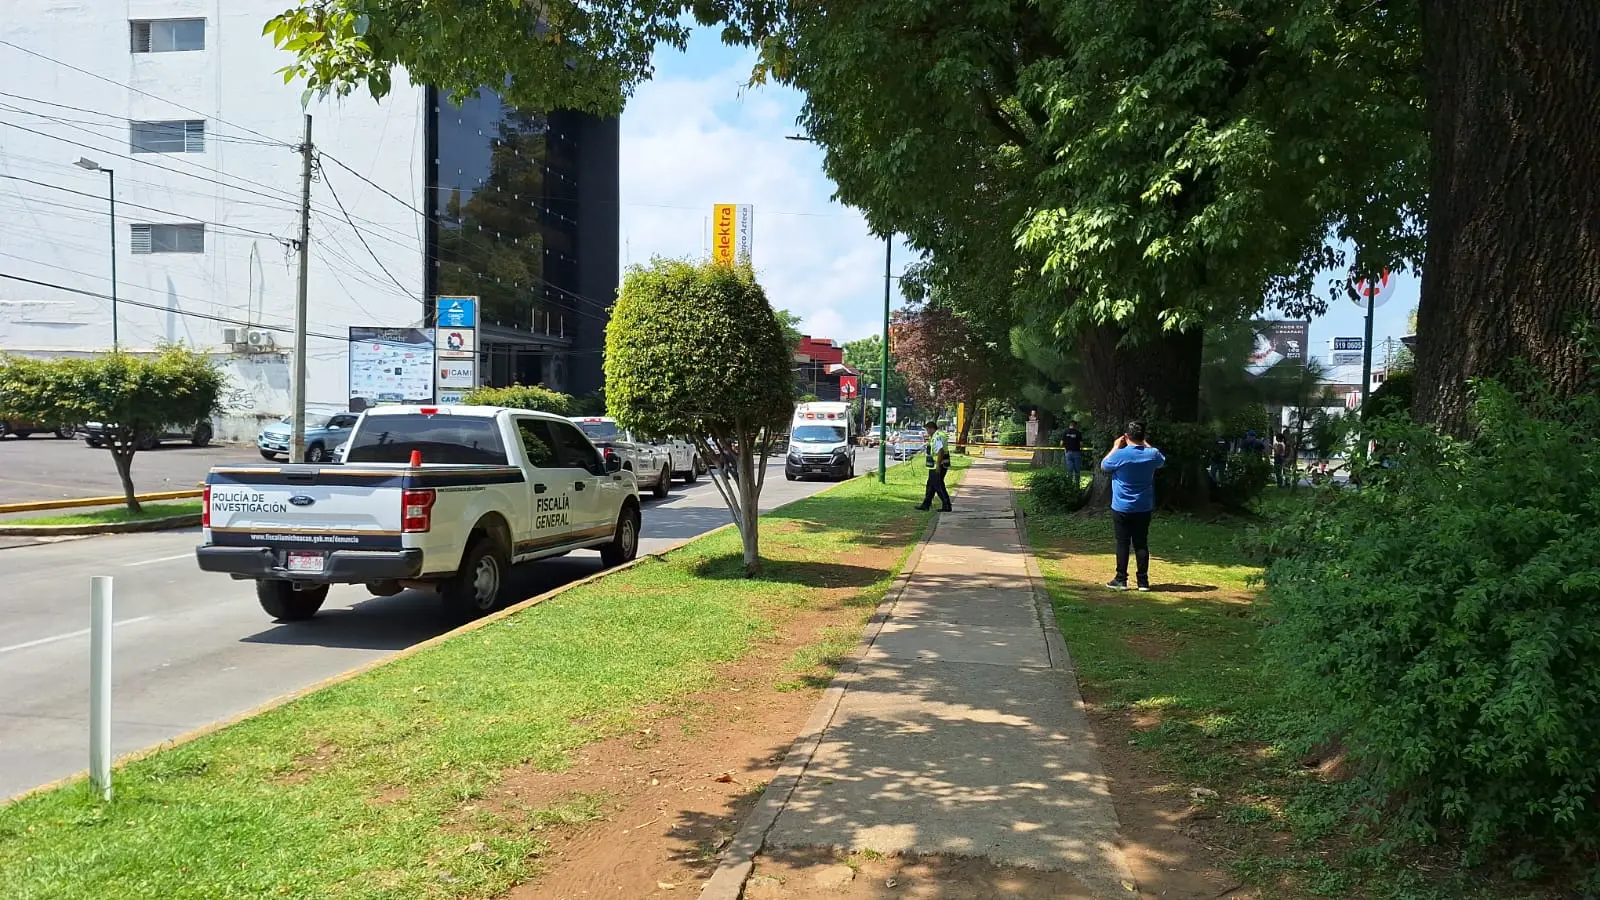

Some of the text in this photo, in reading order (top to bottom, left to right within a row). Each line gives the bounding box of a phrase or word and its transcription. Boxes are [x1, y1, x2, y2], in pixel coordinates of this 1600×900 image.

[718, 207, 731, 257] elektra
[448, 369, 472, 377] ICAMI
[212, 490, 265, 502] POLICÍA DE
[212, 501, 287, 513] INVESTIGACIÓN
[536, 492, 570, 513] FISCALÍA
[535, 511, 570, 530] GENERAL
[250, 533, 360, 544] www.fiscaliamichoacan.gob.mx/denuncia
